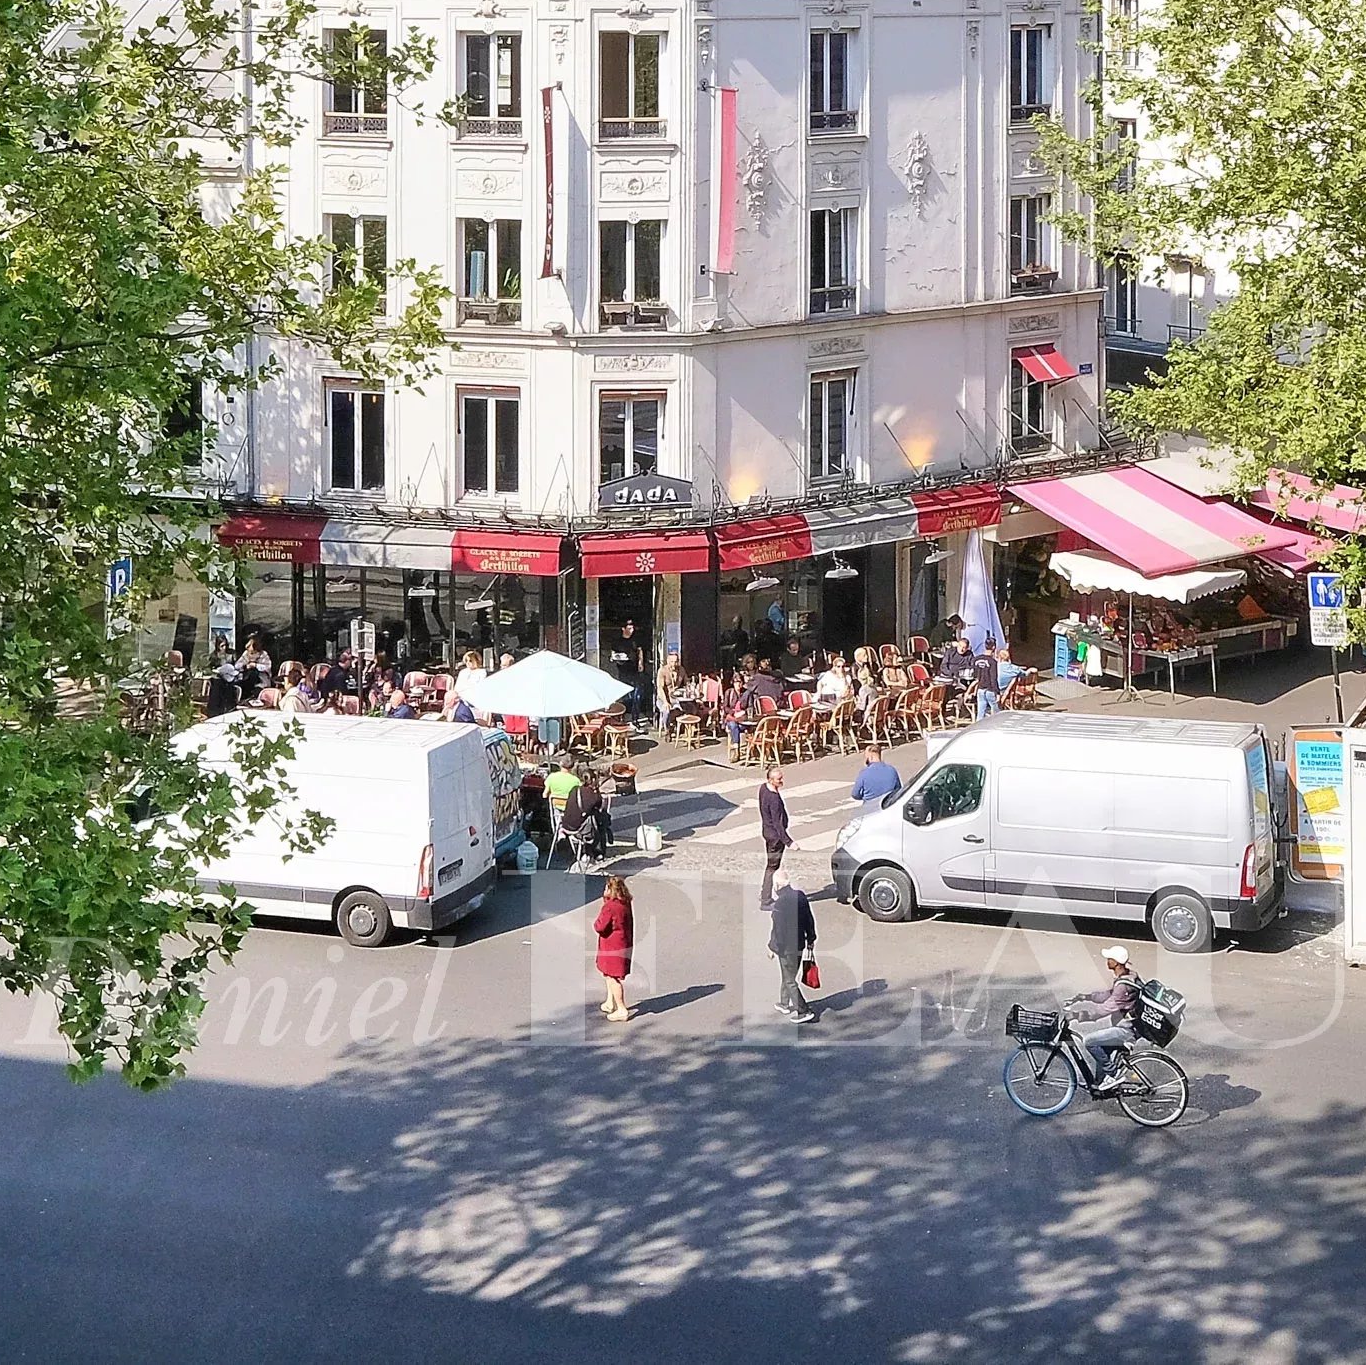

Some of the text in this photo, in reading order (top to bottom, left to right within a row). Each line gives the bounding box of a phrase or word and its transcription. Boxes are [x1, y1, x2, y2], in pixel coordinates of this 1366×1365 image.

[479, 558, 530, 572] Berthillon
[115, 569, 126, 597] P
[1140, 1011, 1162, 1030] Eats
[1144, 1005, 1164, 1021] Uber
